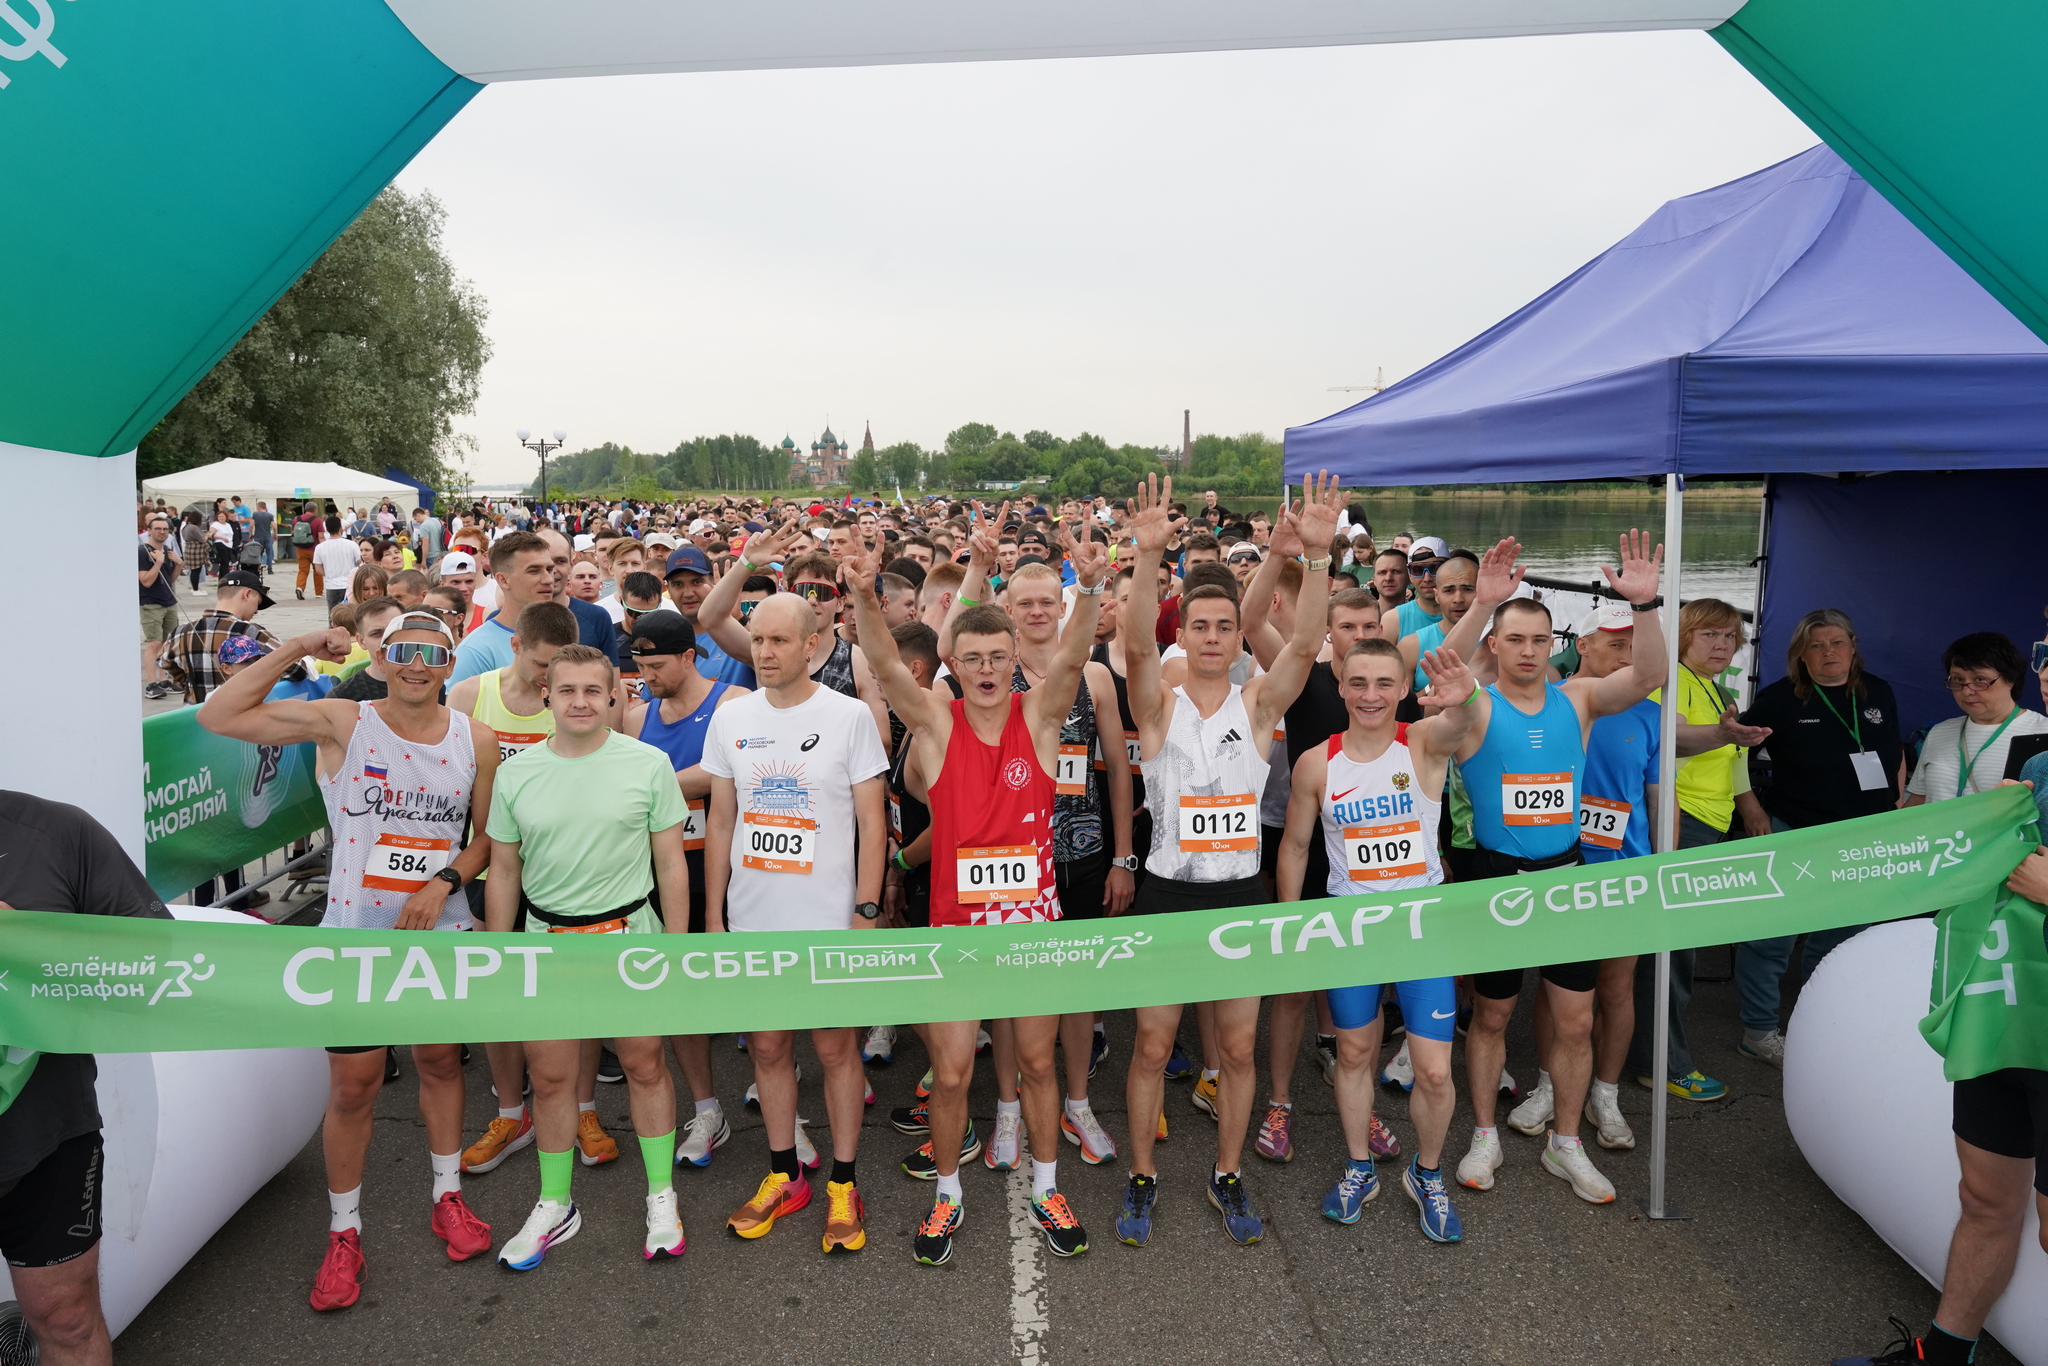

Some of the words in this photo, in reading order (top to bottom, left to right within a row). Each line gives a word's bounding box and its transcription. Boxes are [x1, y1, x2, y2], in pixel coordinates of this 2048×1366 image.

[499, 746, 526, 762] 58
[347, 786, 463, 822] Ярославль
[384, 788, 450, 810] ФЕРРУМ
[1333, 792, 1414, 825] RUSSIA
[1514, 789, 1565, 810] 0298
[1192, 811, 1247, 835] 0112
[751, 830, 803, 855] 0003
[1357, 839, 1412, 864] 0109
[1839, 835, 1930, 863] зелёный
[388, 852, 427, 874] 584
[970, 862, 1026, 885] 0110
[1831, 859, 1922, 883] марафон
[1544, 874, 1648, 913] СБЕР
[1672, 867, 1758, 897] Прайм
[1208, 897, 1442, 960] СТАРТ
[1009, 934, 1105, 951] зелёный
[1963, 900, 2018, 1006] РТ
[40, 954, 156, 978] зелёный
[681, 949, 800, 980] СБЕР
[824, 949, 917, 973] Прайм
[996, 948, 1095, 969] марафон
[282, 946, 553, 1006] СТАРТ
[31, 979, 145, 1002] марафон
